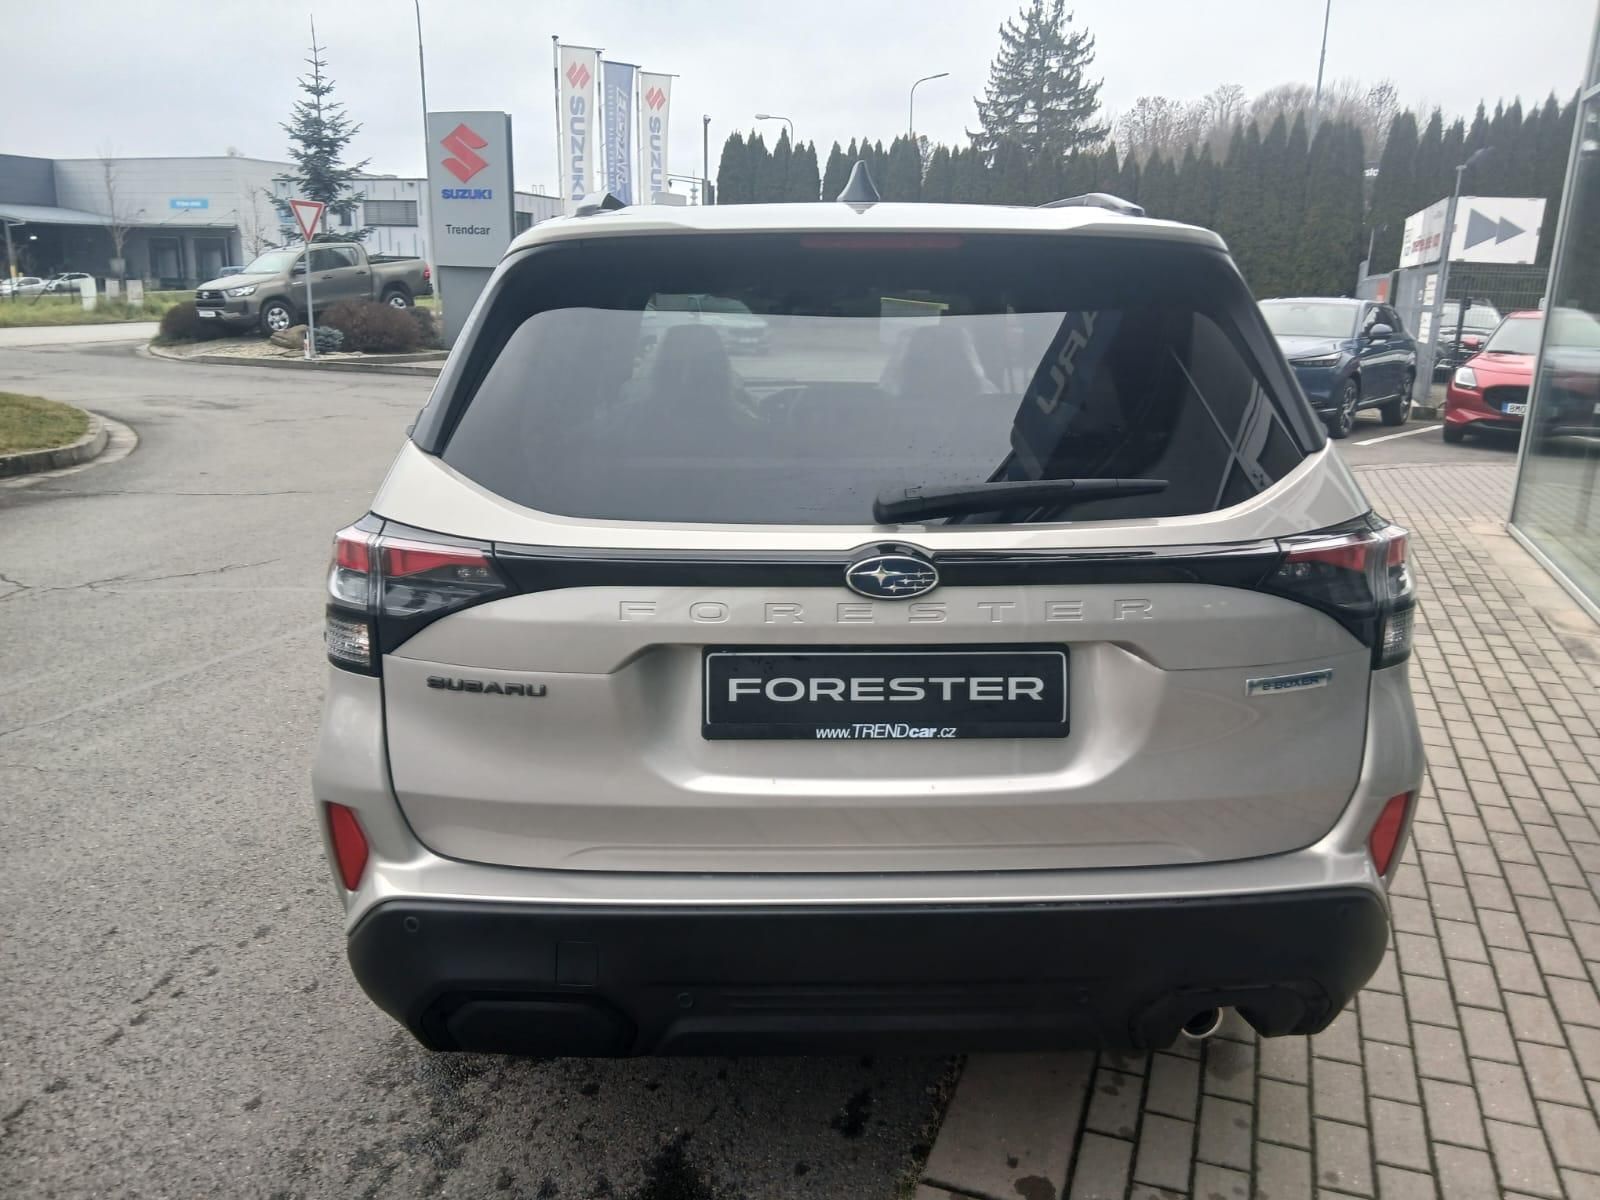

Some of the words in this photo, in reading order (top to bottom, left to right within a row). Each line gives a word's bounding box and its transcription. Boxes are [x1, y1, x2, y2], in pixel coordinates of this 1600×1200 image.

[569, 95, 586, 200] SUZUKI
[649, 116, 662, 192] SUZU
[441, 188, 493, 200] SUZUKI
[445, 224, 491, 235] Trendcar
[619, 599, 1153, 624] FORESTER
[426, 675, 547, 697] SUBARU
[728, 676, 1045, 702] FORESTER
[815, 722, 957, 739] www.TRENDcar.cz
